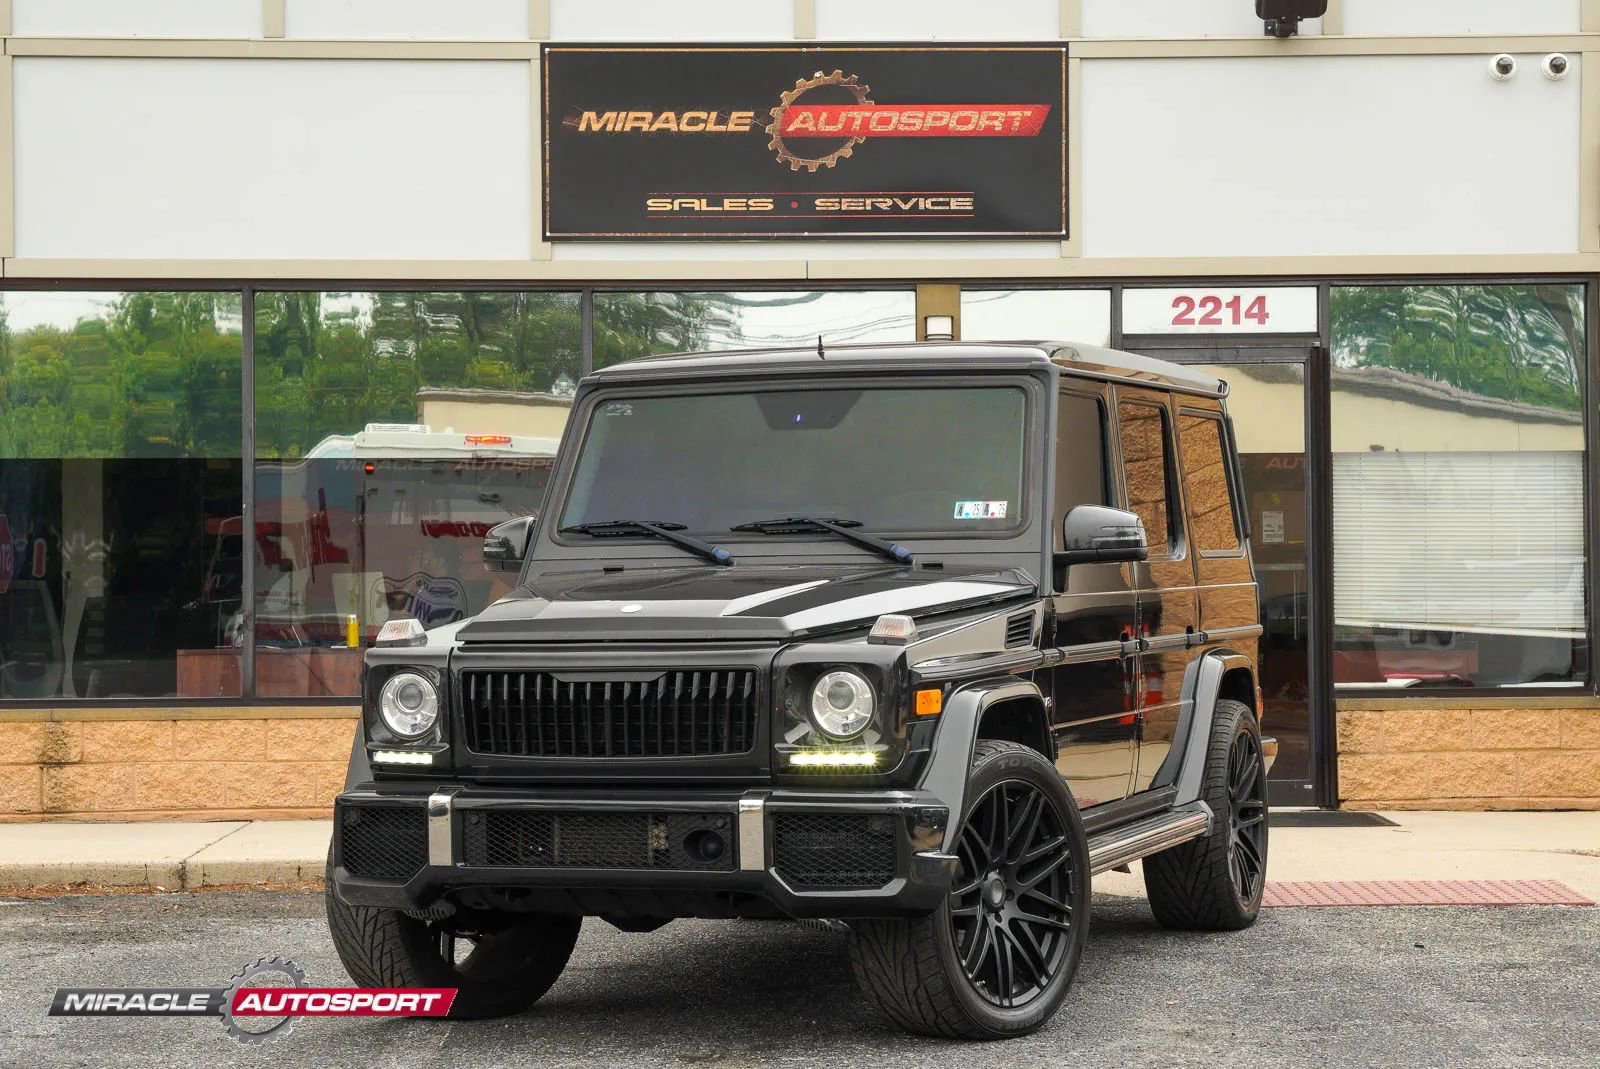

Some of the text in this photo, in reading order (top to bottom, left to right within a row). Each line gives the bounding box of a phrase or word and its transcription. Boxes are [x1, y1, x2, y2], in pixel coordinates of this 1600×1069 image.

[577, 111, 1033, 132] MIRACLE AUTOSPORT
[646, 197, 974, 211] SALES SERVICE
[1170, 295, 1270, 325] 2214
